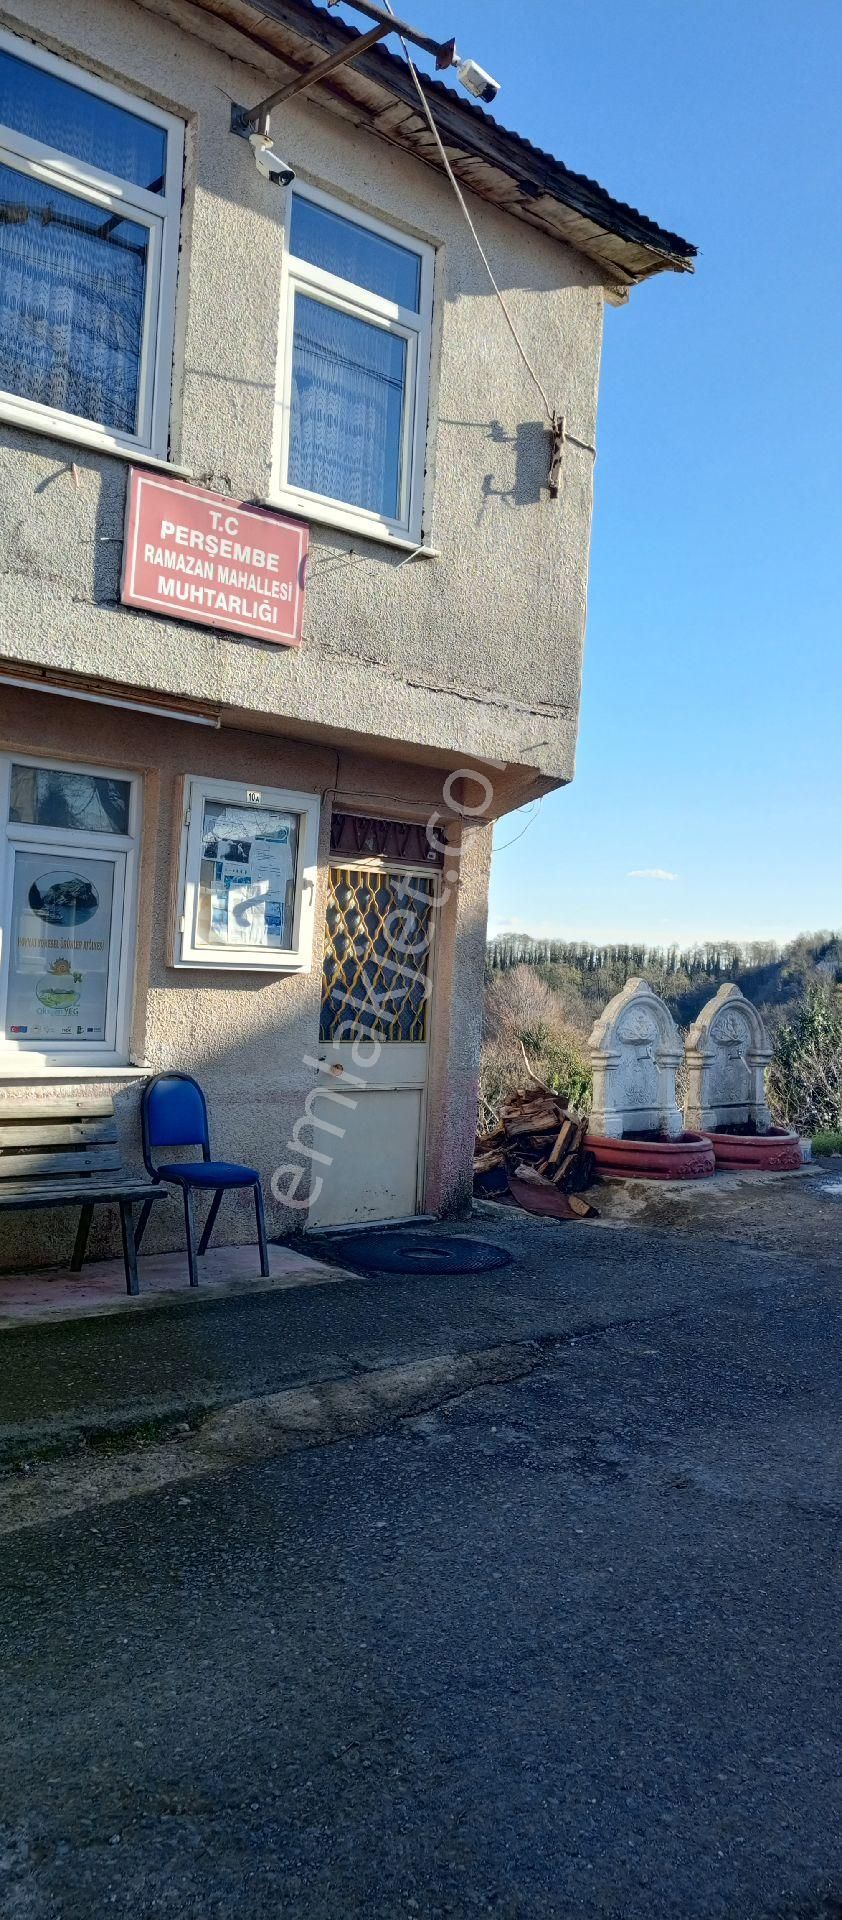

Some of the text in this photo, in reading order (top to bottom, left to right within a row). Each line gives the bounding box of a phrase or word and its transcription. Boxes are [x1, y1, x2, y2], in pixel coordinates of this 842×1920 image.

[160, 520, 280, 573] PERŞEMBE
[208, 510, 240, 536] T.C
[144, 543, 293, 602] RAMAZAN MAHALLESİ
[157, 575, 278, 624] MUHTARLIĞI
